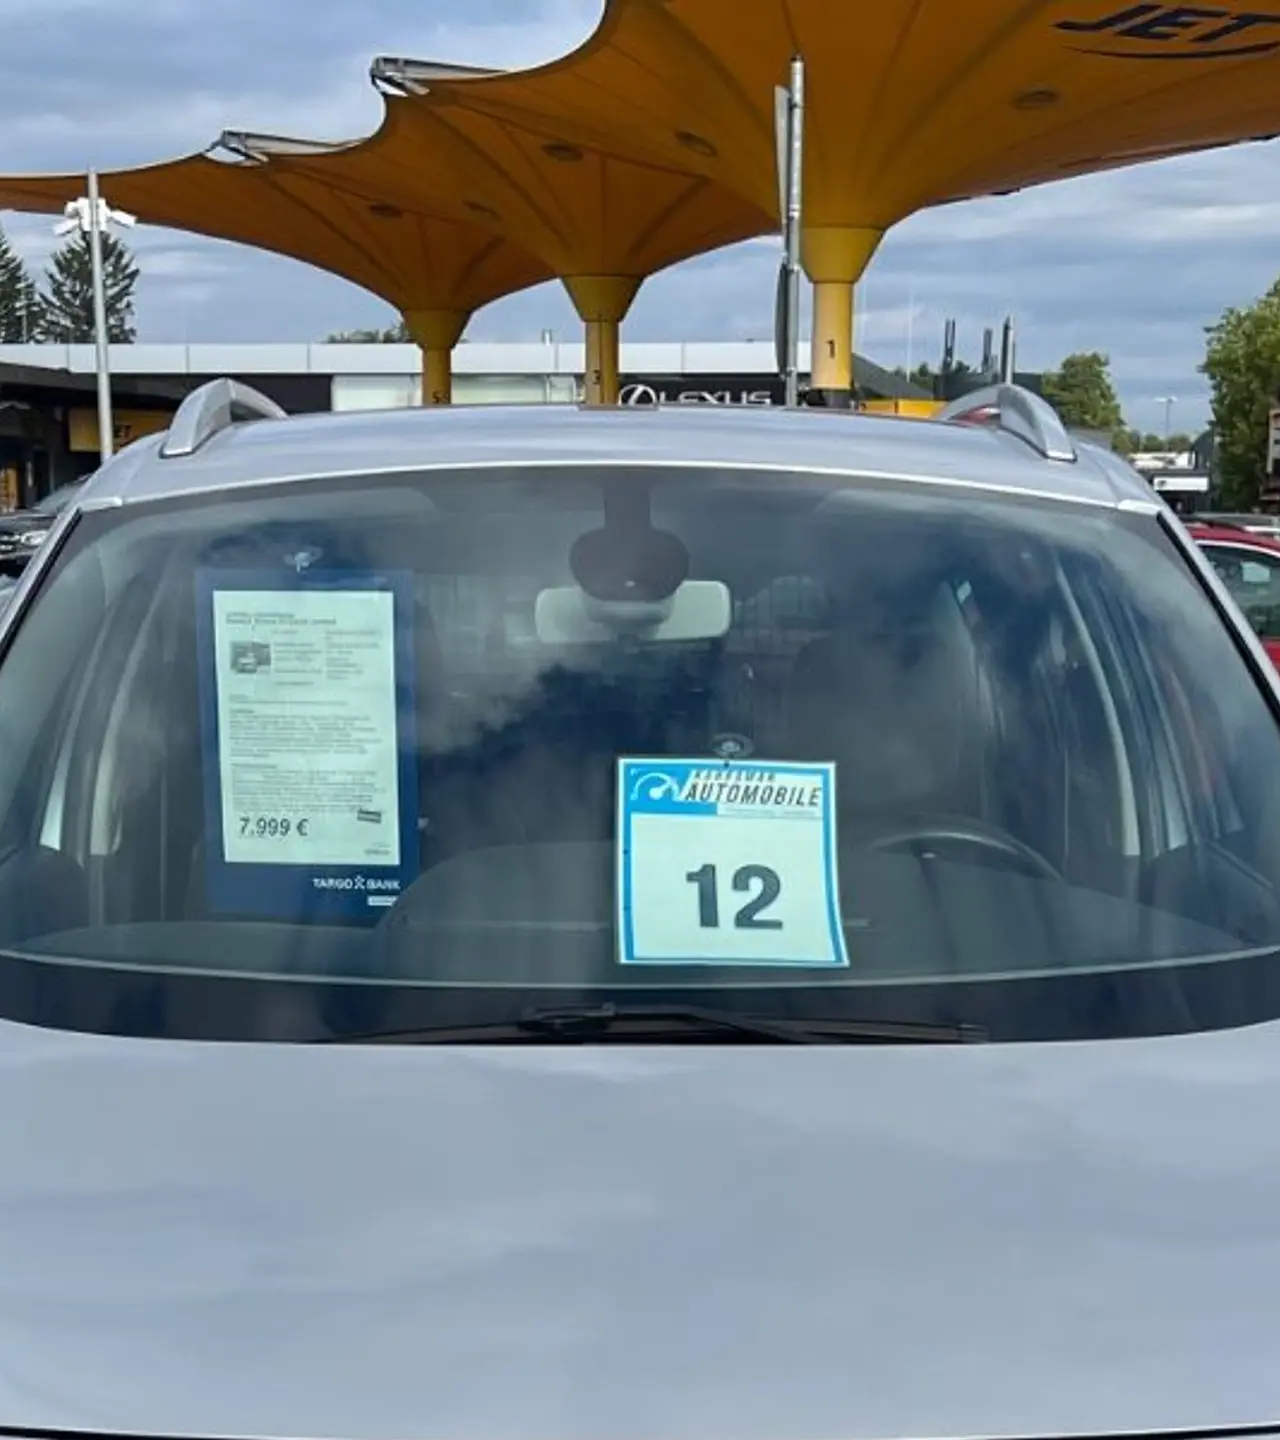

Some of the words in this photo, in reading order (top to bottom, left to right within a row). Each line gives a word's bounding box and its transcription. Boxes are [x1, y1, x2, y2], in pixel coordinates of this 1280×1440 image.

[685, 781, 822, 807] AUTOMOBILE
[239, 816, 291, 838] 7.999
[296, 818, 310, 837] €
[686, 864, 783, 930] 12
